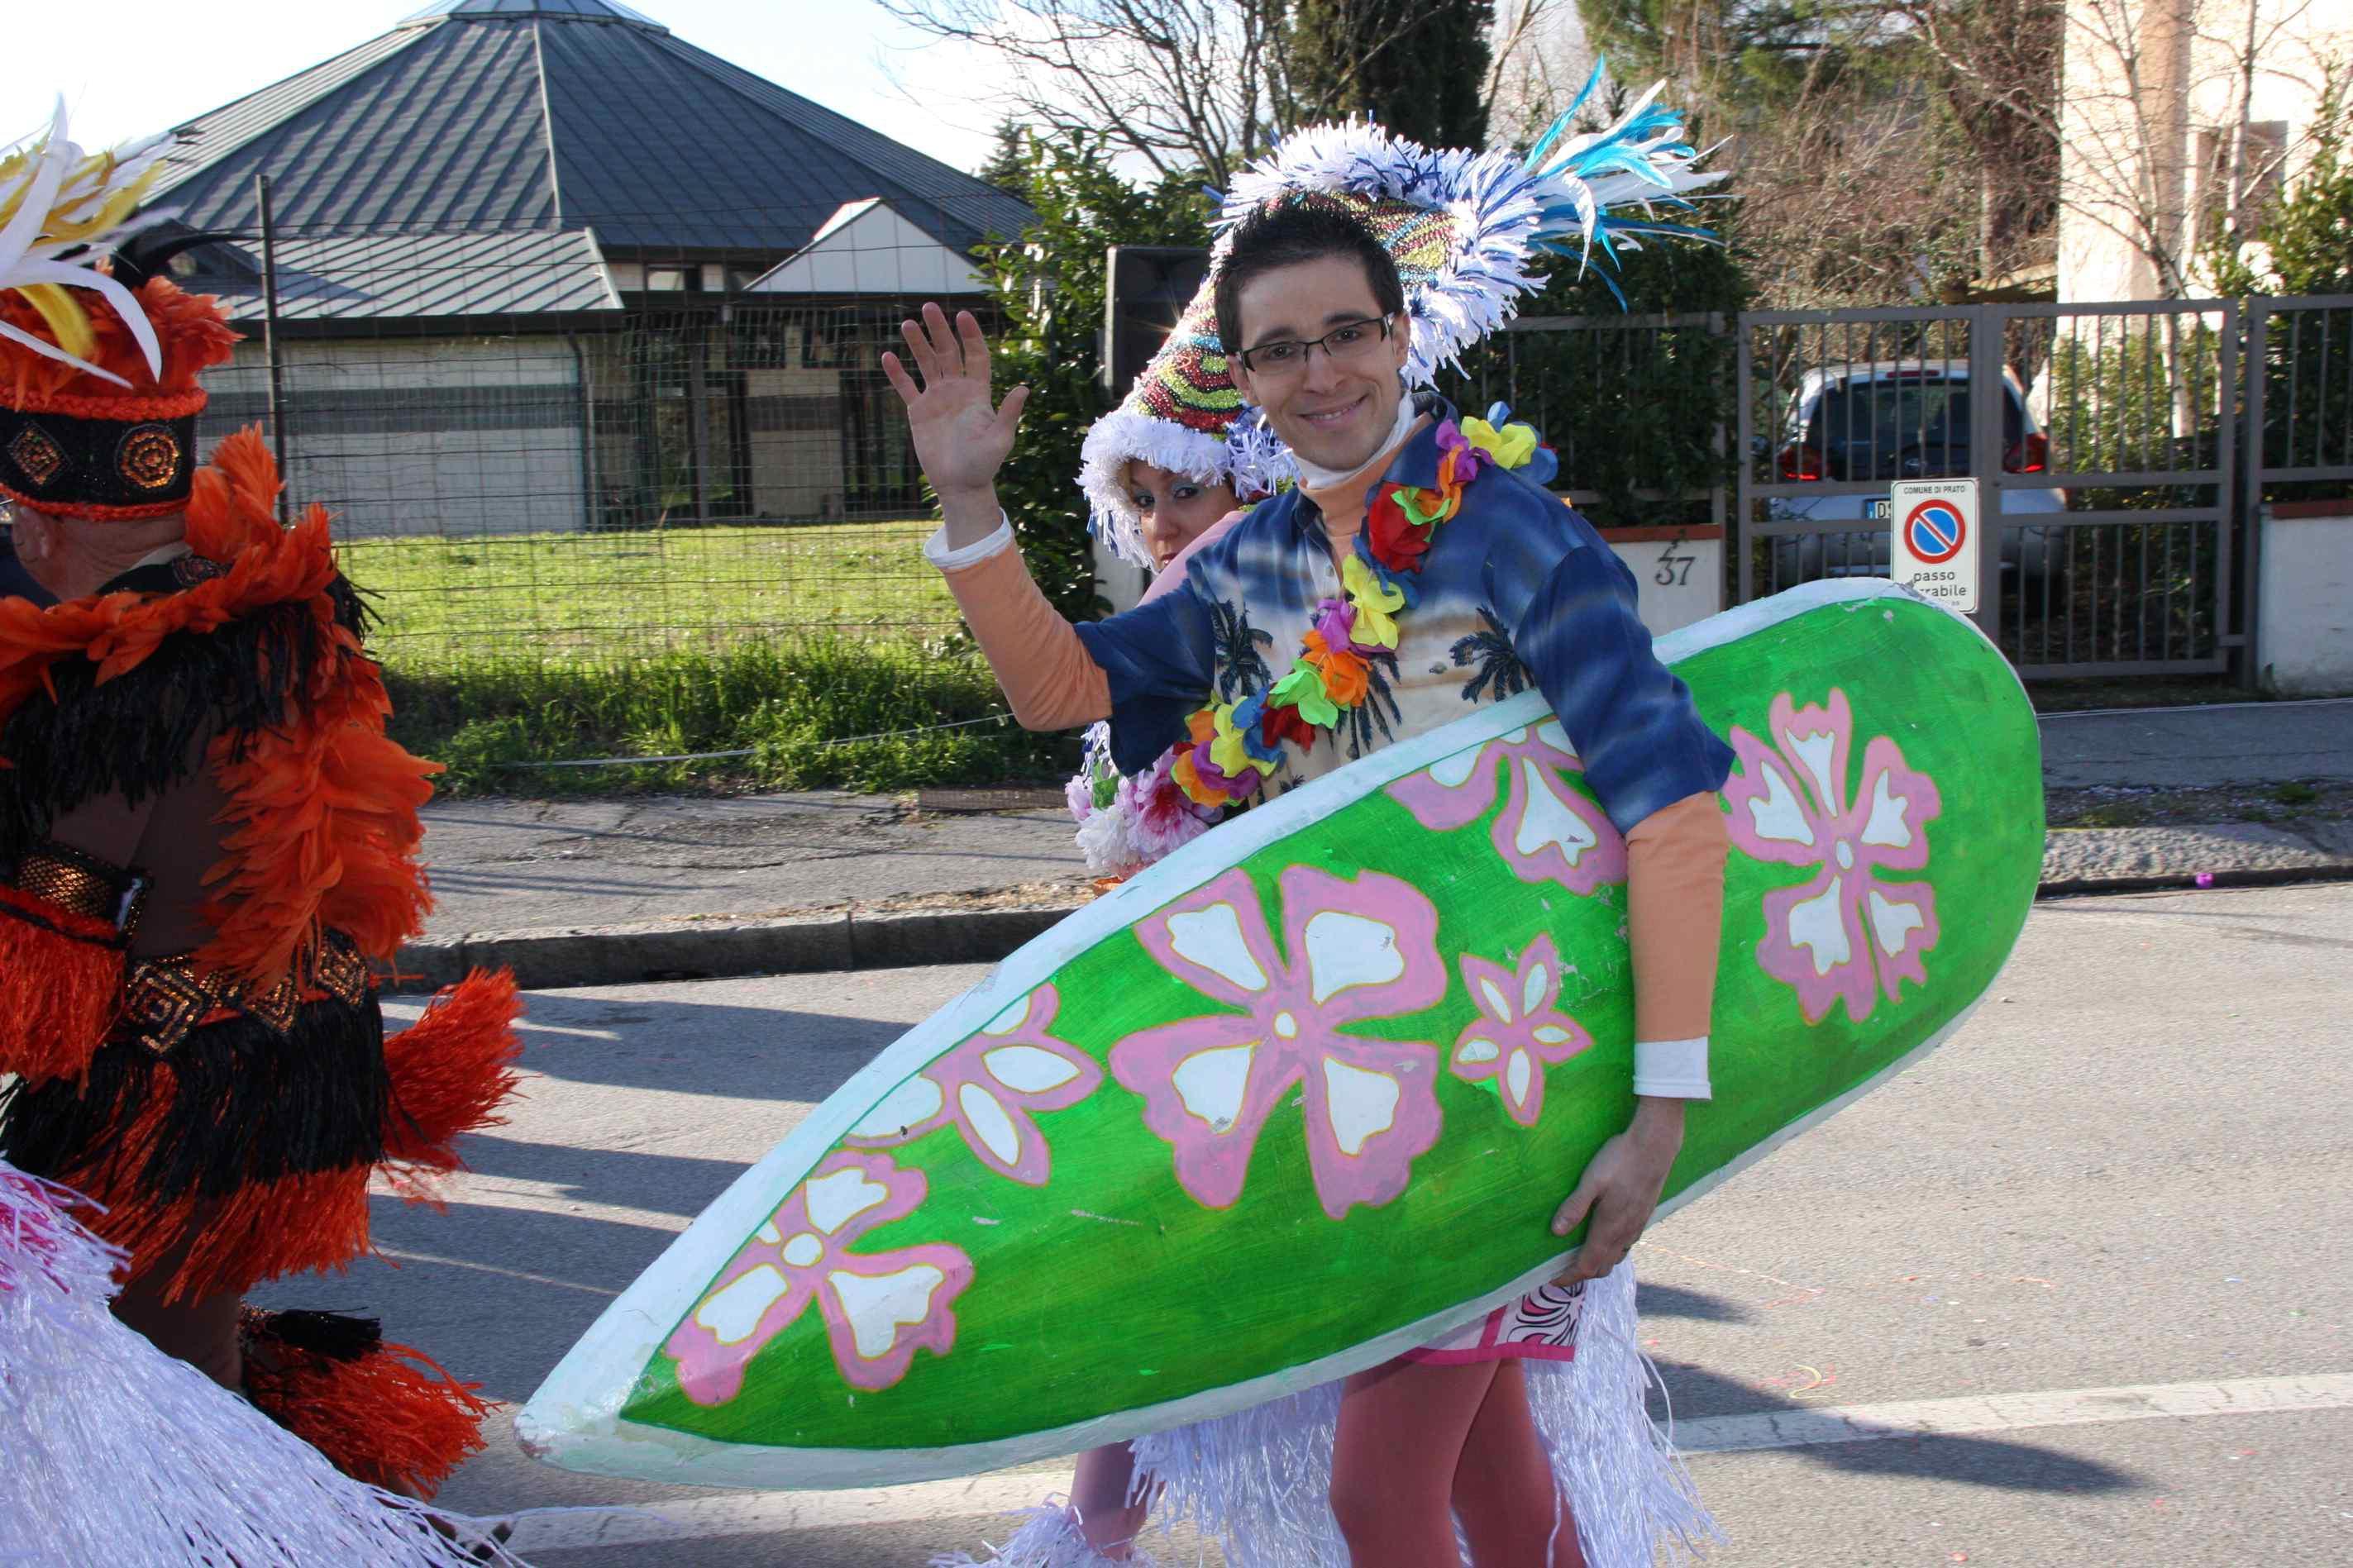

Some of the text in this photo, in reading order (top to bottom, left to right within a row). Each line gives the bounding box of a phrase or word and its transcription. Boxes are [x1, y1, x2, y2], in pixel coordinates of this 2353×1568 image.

[1904, 486, 1932, 494] COMUNE
[1654, 556, 1696, 585] 37
[1913, 571, 1955, 584] passo
[1919, 584, 1967, 597] rabile
